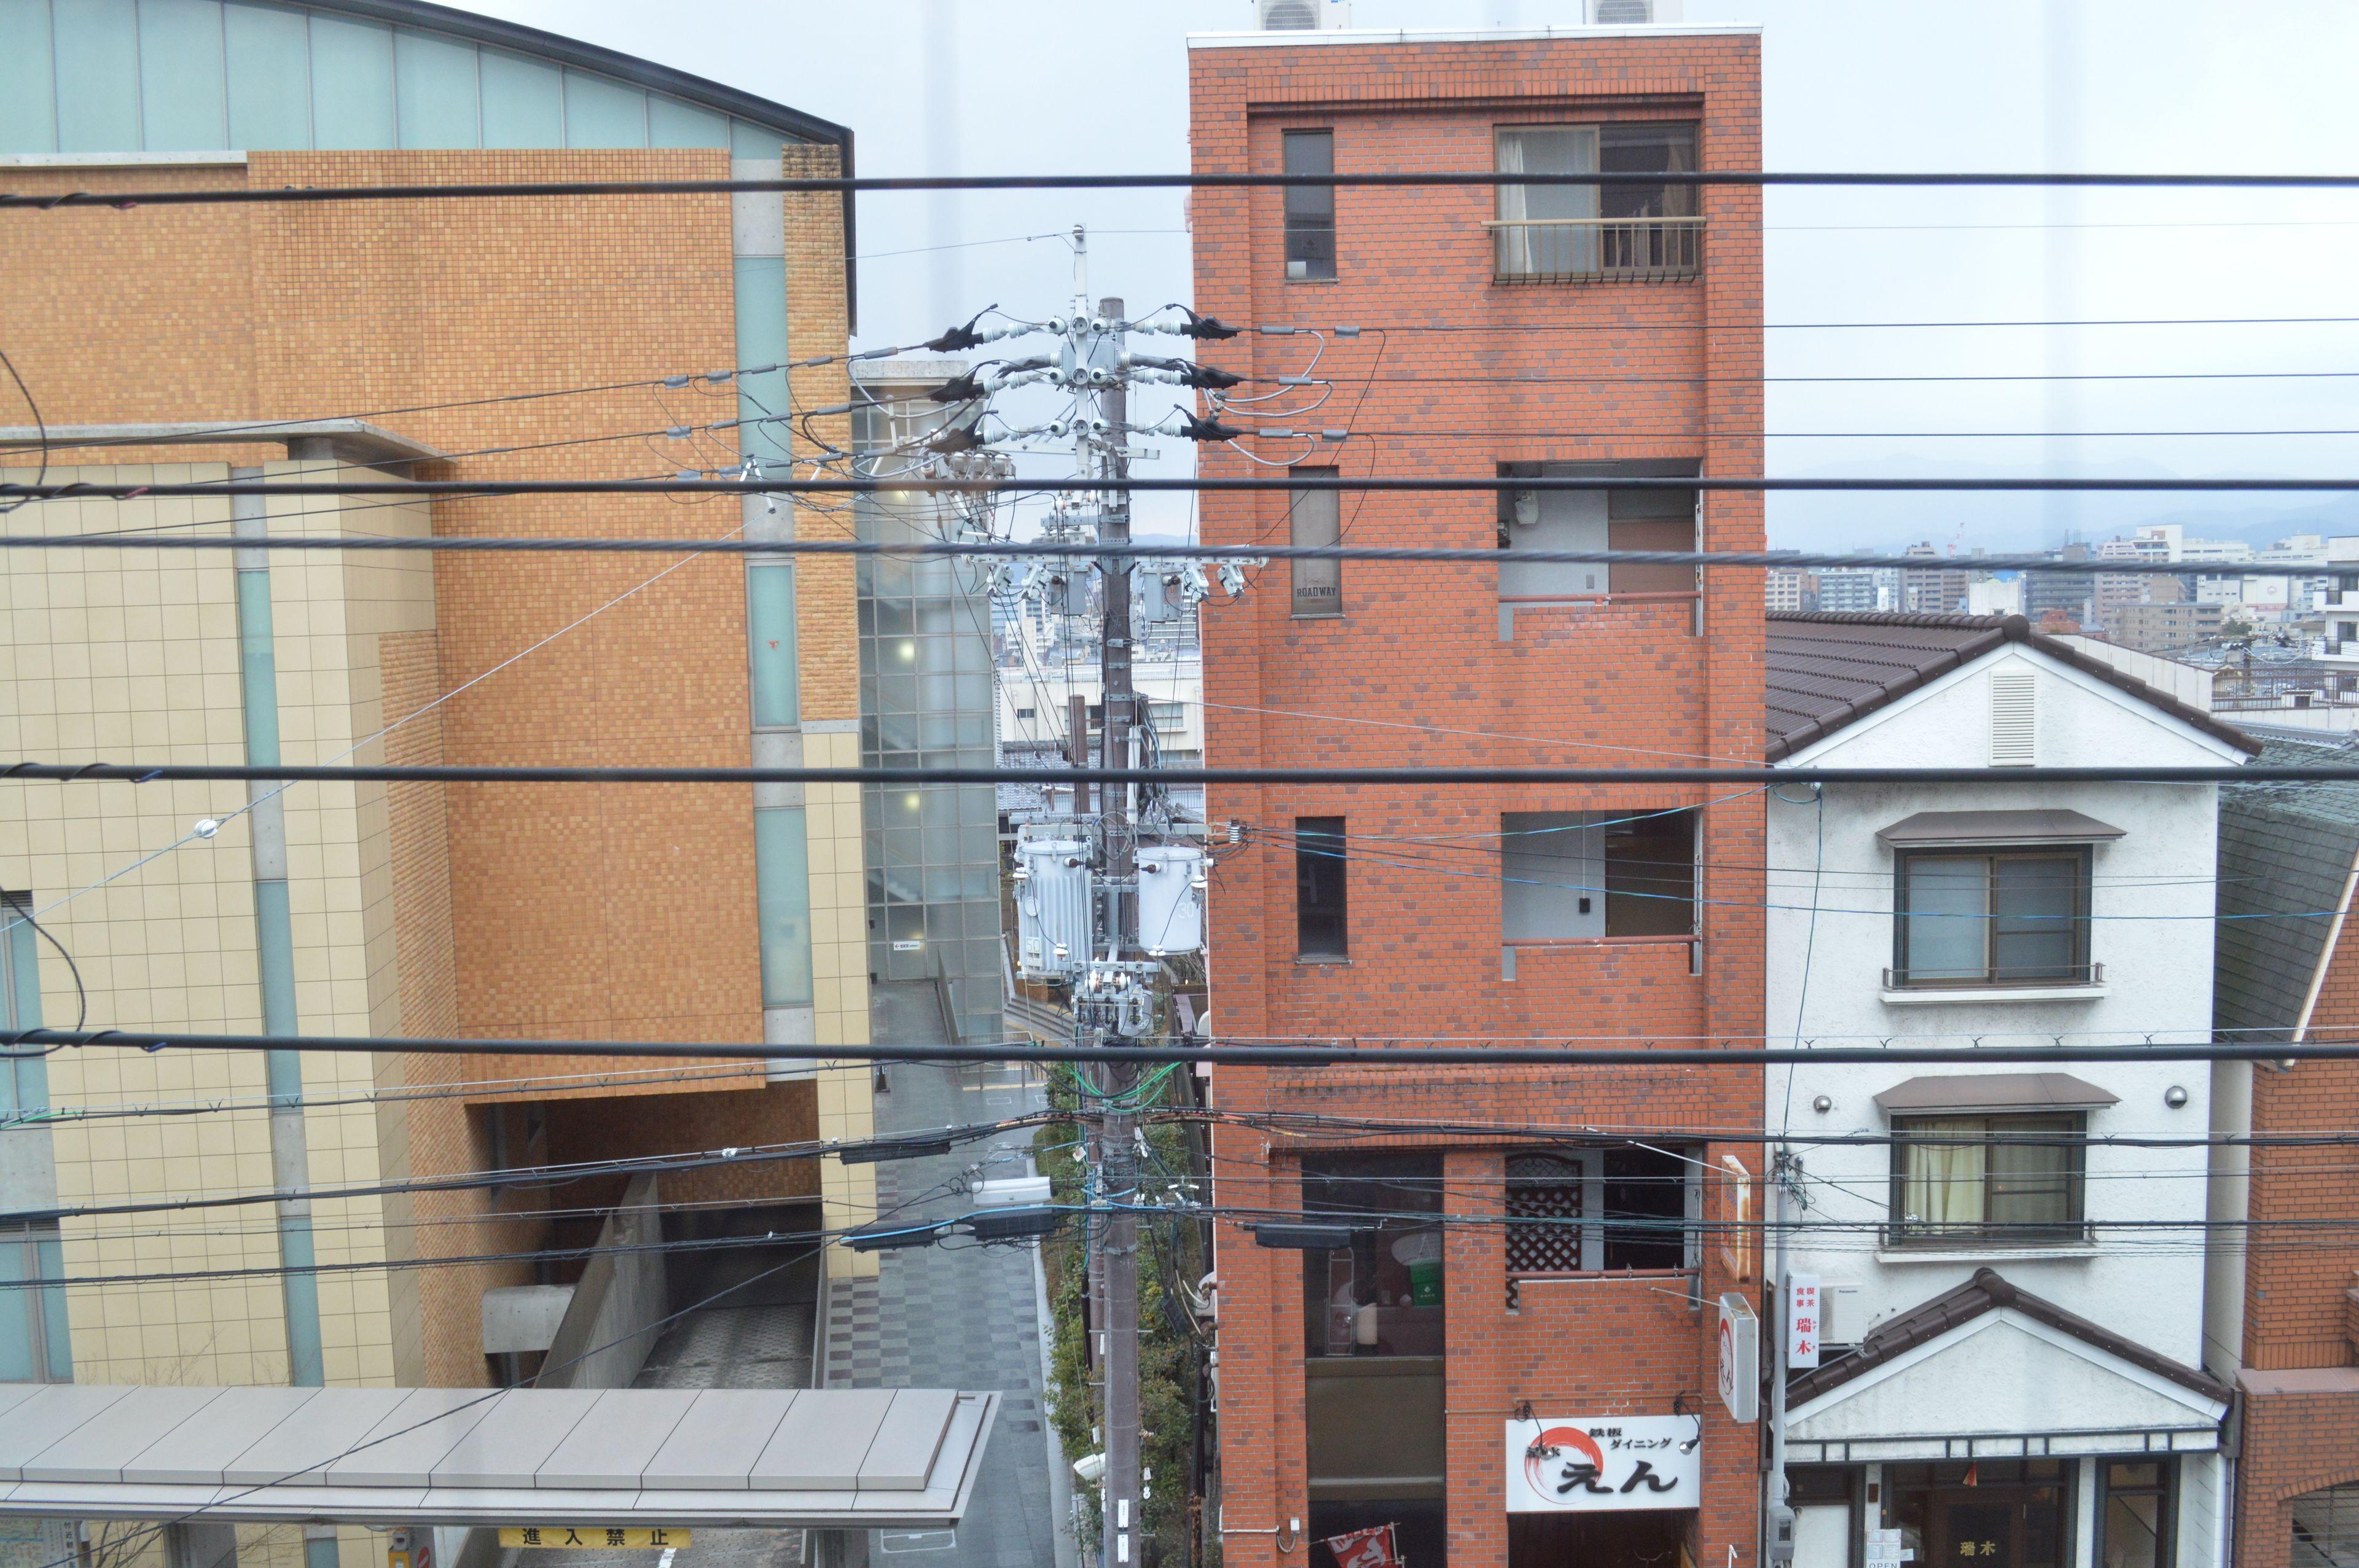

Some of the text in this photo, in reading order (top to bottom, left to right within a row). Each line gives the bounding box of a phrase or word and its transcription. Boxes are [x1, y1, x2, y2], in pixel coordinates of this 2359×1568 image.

[1297, 587, 1336, 597] ROADWAY
[1178, 902, 1194, 918] 30
[1026, 938, 1041, 953] 50
[1796, 1287, 1804, 1308] 食事
[1807, 1287, 1815, 1307] 喫茶
[1796, 1318, 1812, 1355] 瑞木
[1589, 1427, 1622, 1438] 鉄板
[1610, 1438, 1672, 1450] ダイニング
[1557, 1460, 1678, 1494] えん
[522, 1527, 669, 1547] 進入禁止
[1960, 1540, 1996, 1556] 瑞木
